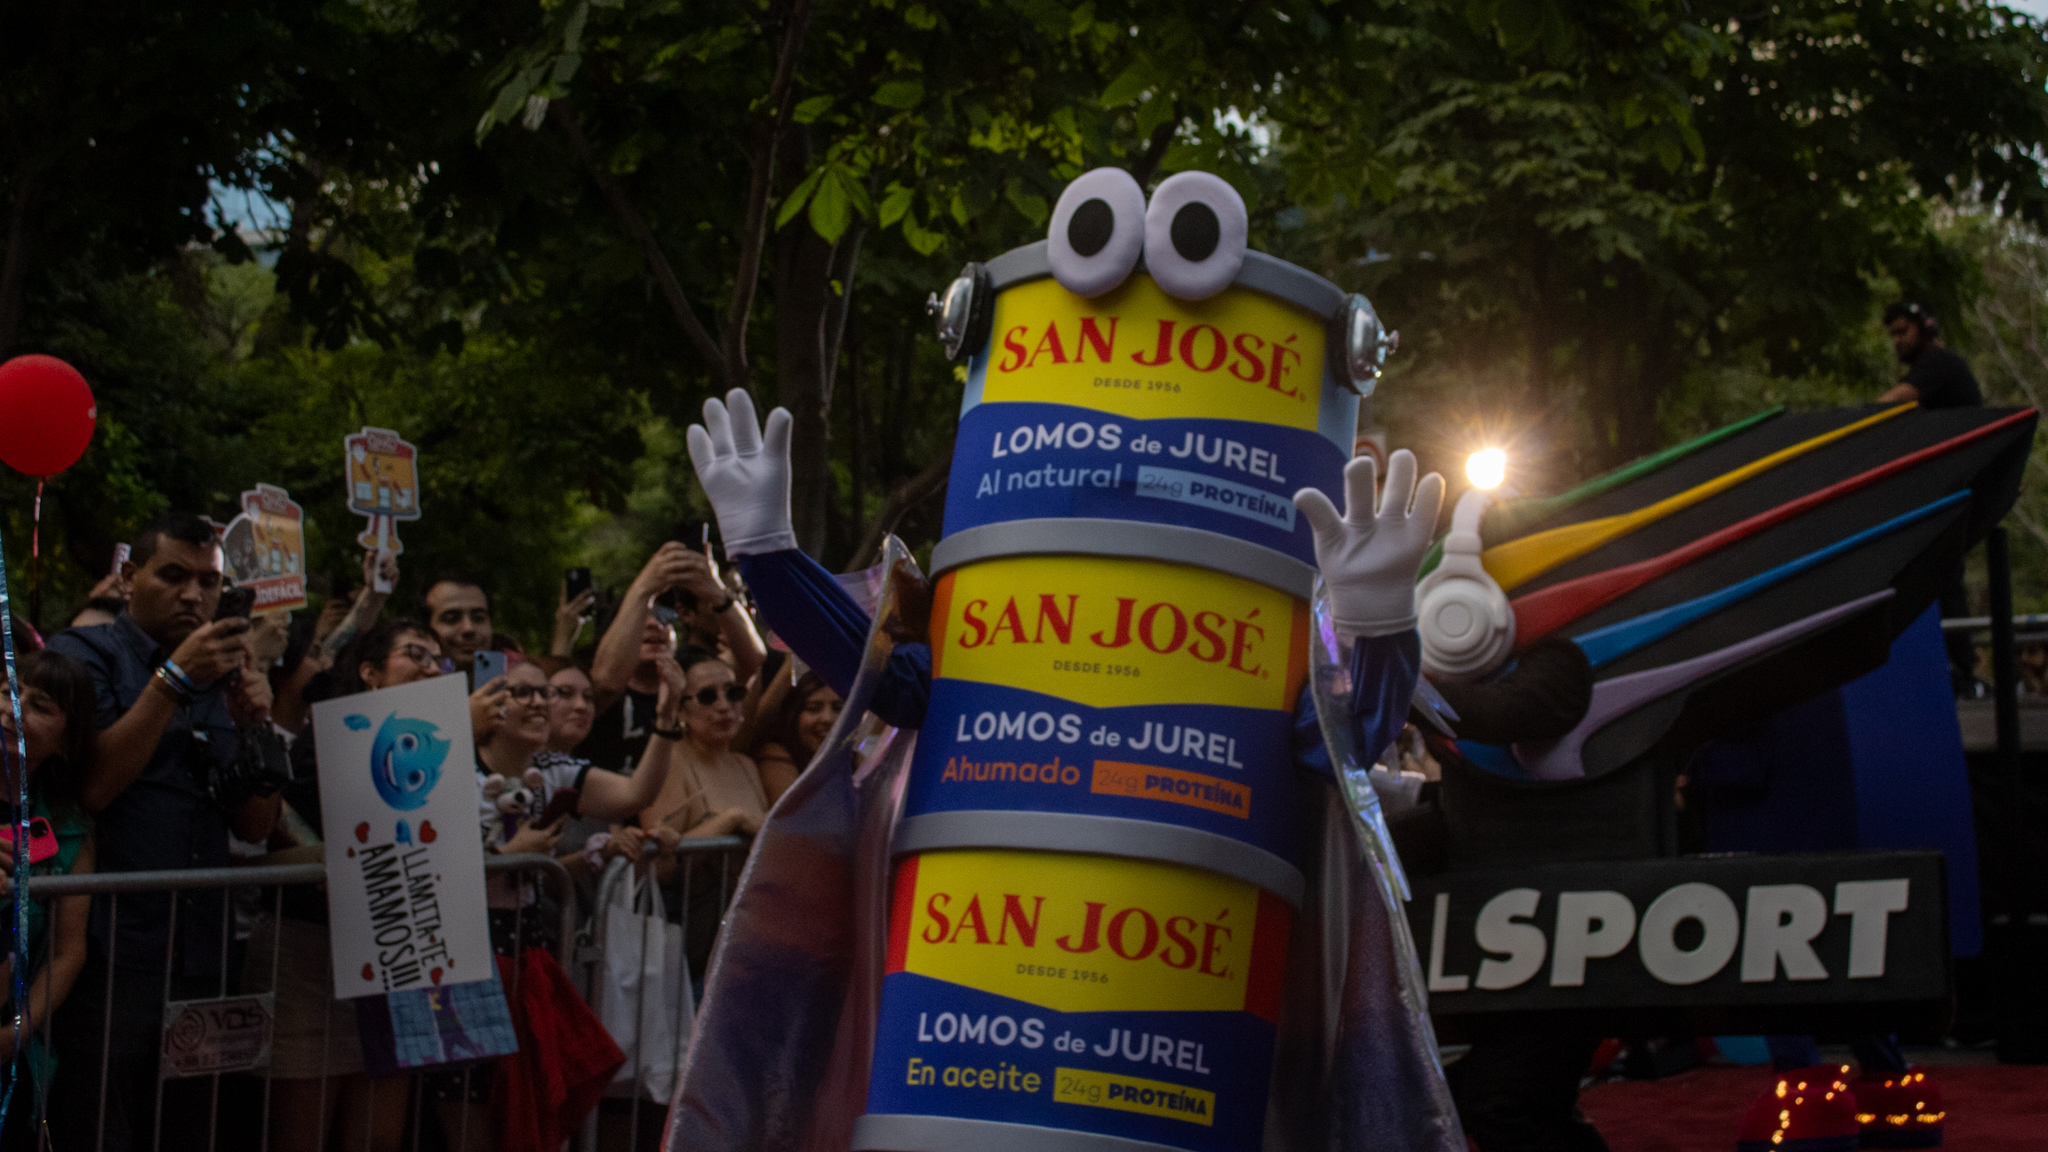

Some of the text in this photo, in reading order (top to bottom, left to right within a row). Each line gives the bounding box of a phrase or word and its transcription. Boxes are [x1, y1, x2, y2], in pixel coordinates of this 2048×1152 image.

[999, 317, 1301, 397] SAN JOSÉ
[1093, 376, 1182, 394] DESDE 1956
[992, 421, 1286, 485] LOMOS de JUREL
[976, 463, 1288, 522] Al natural 24g PROTEÍNA
[959, 593, 1265, 676] SAN JOSÉ
[1053, 660, 1141, 678] DESDE 1956
[956, 711, 1244, 770] LOMOS de JUREL
[941, 756, 1245, 810] Ahumado 24g PROTEÍNA
[922, 892, 1233, 979] SAN JOSÉ
[1427, 877, 1910, 993] LSPORT
[1017, 963, 1109, 985] DESDE 1956
[917, 1012, 1211, 1075] LOMOS de JUREL
[906, 1058, 1207, 1117] En aceite 24g PROTEÍNA
